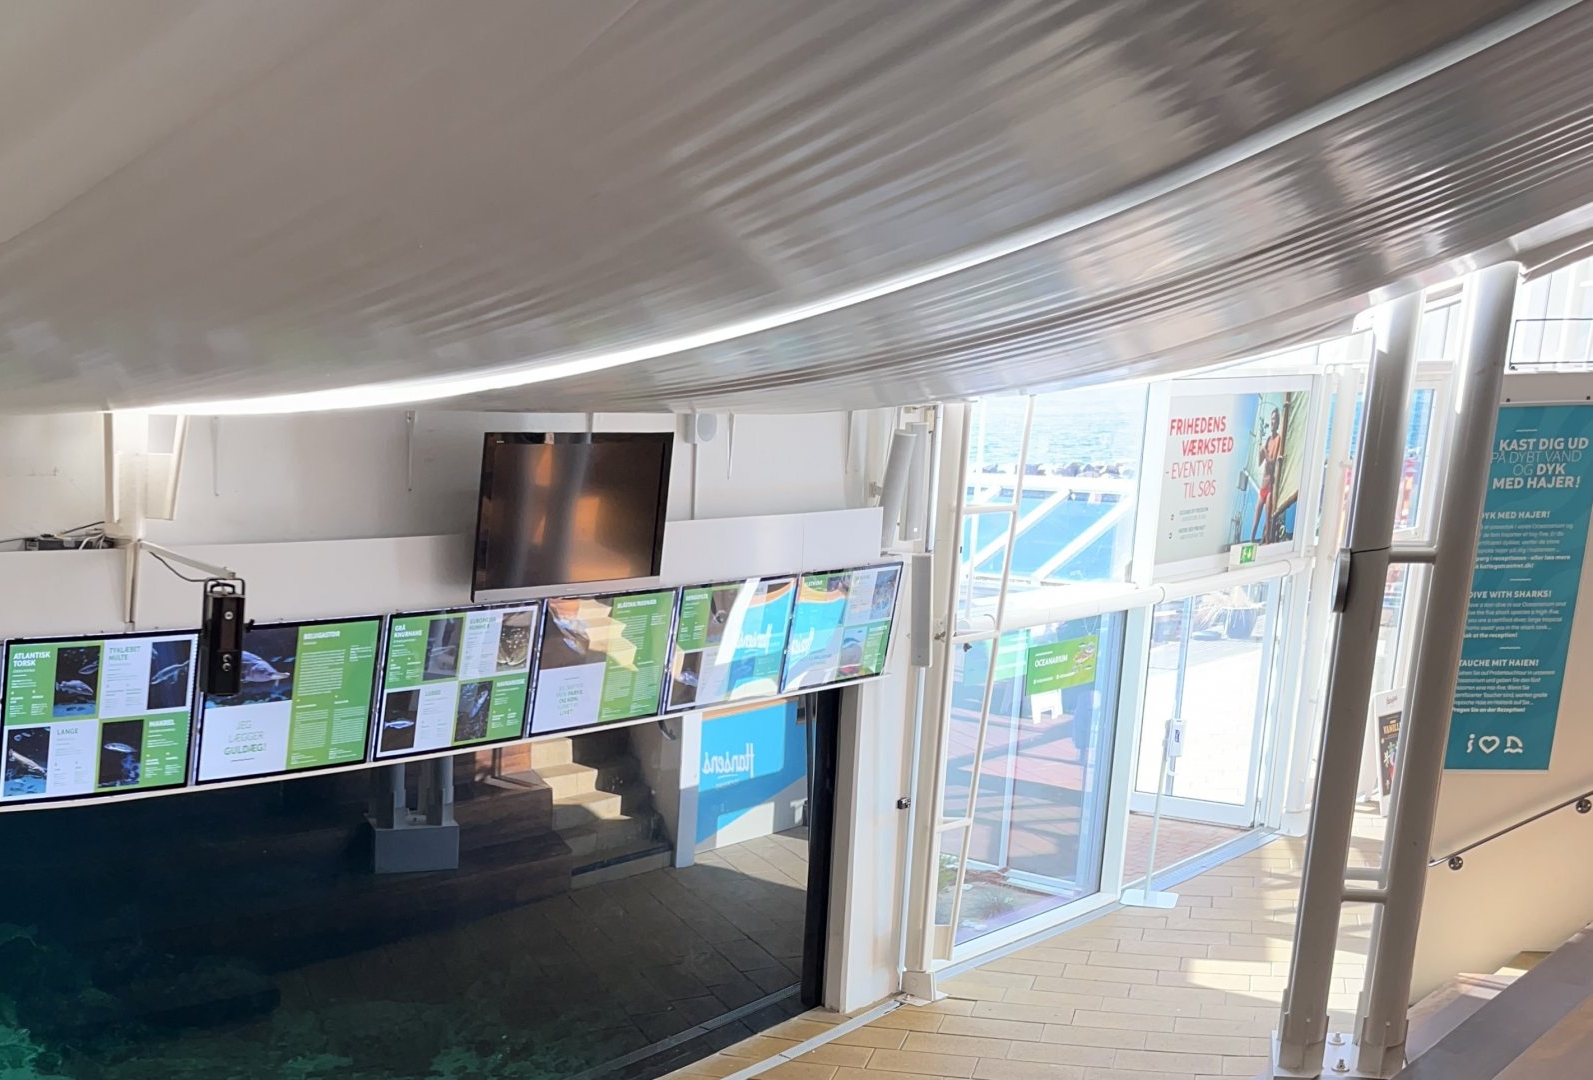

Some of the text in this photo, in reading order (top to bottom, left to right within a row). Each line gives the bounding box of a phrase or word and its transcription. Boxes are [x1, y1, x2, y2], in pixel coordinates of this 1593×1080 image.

[1169, 416, 1227, 436] FRIHEDENS
[1182, 436, 1234, 457] VÆRKSTED
[1499, 437, 1589, 451] KAST DIG UD
[1509, 450, 1544, 463] DYBT
[1546, 450, 1583, 463] VAND
[1171, 460, 1213, 479] EVENTYR
[1512, 462, 1567, 476] OG DYK
[1184, 480, 1217, 499] TIL SØS
[1492, 476, 1581, 489] MED HAJER!
[1497, 511, 1517, 519] MED
[1518, 510, 1550, 518] HAJER!
[1489, 590, 1512, 598] WITH
[1513, 590, 1552, 598] SHARKS!
[13, 651, 51, 660] ATLANTISK
[1034, 654, 1068, 668] OCEANARIUM
[1491, 659, 1508, 667] MIT
[1508, 658, 1539, 667] HAIEN!
